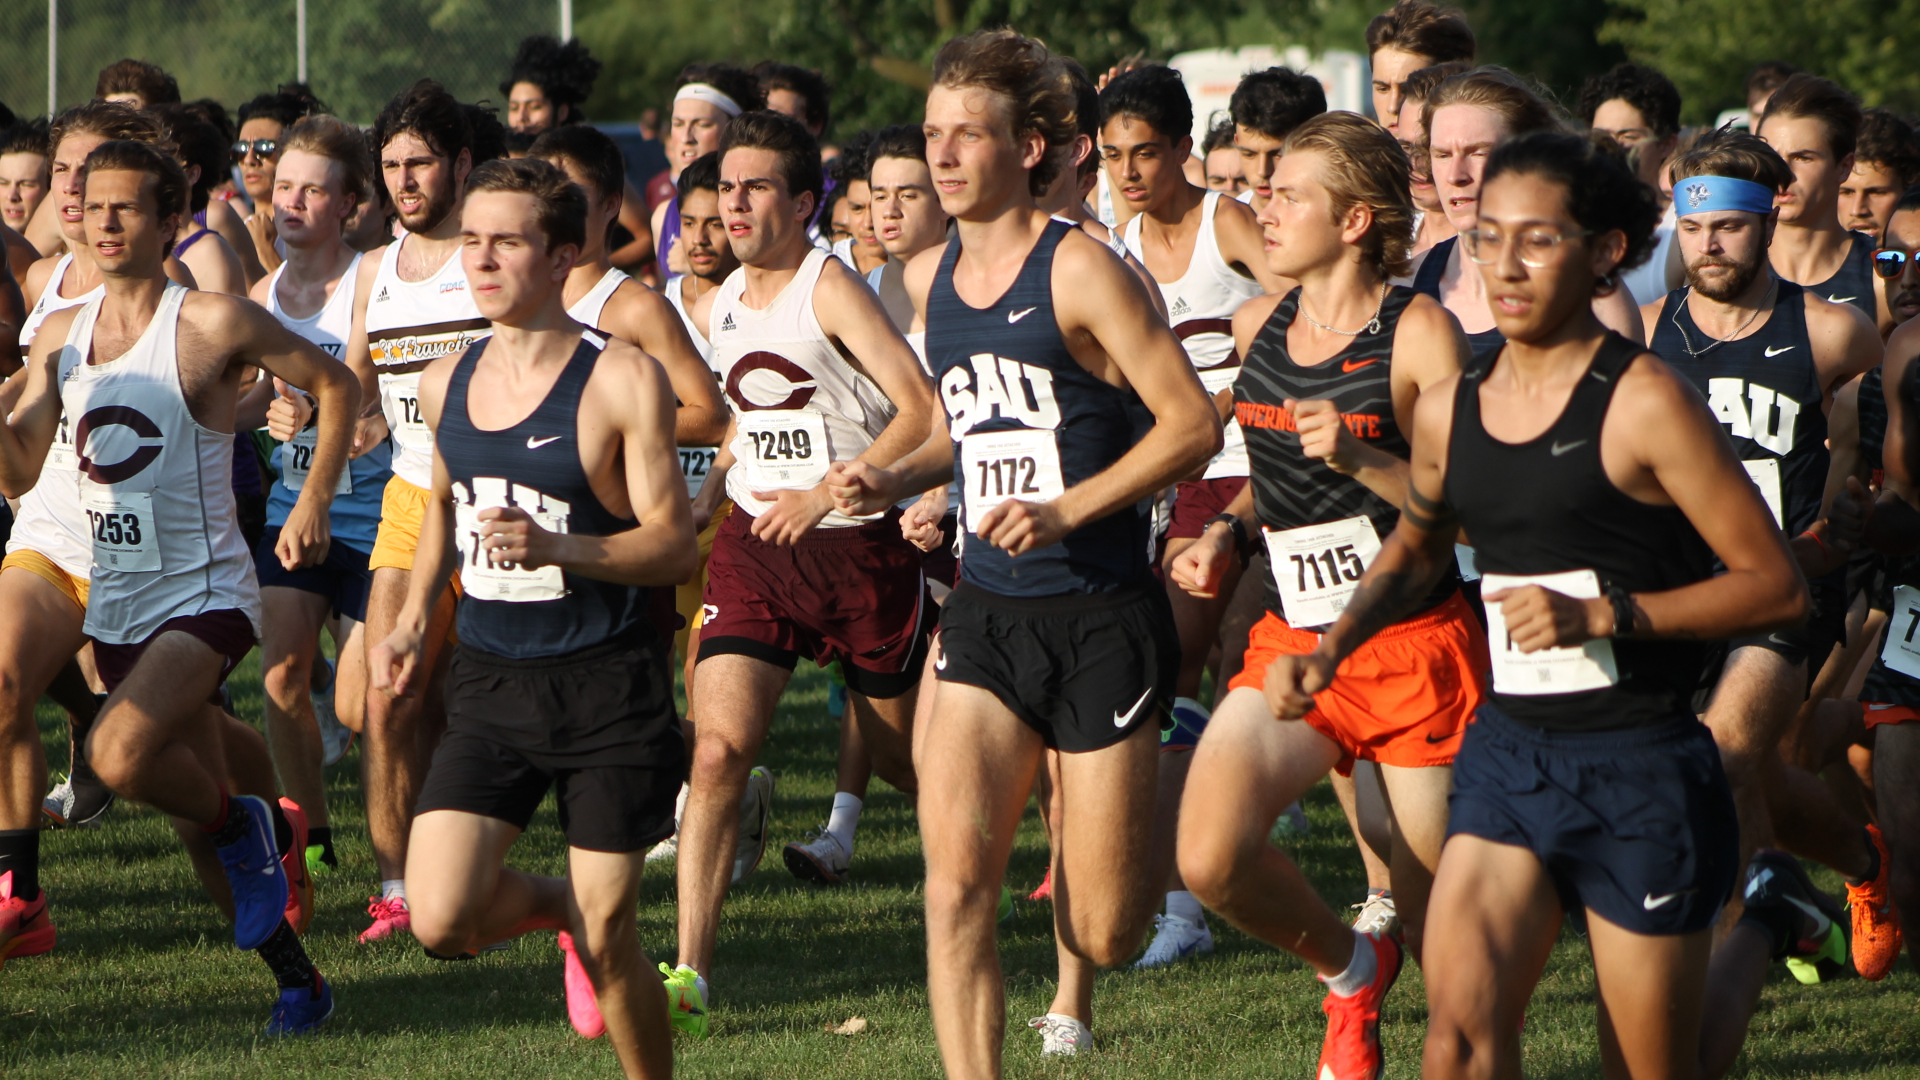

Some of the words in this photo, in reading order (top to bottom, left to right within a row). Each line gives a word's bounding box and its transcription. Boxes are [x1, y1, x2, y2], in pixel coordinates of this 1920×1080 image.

[1170, 307, 1191, 317] adidas
[399, 398, 424, 424] 72
[941, 353, 1061, 442] SAU
[1235, 401, 1299, 433] GOVERNO
[1708, 378, 1800, 457] AU
[76, 405, 164, 485] C
[747, 428, 812, 460] 7249
[679, 450, 716, 477] 721
[976, 456, 1040, 497] 7172
[86, 508, 142, 546] 7253
[1289, 543, 1366, 592] 7115
